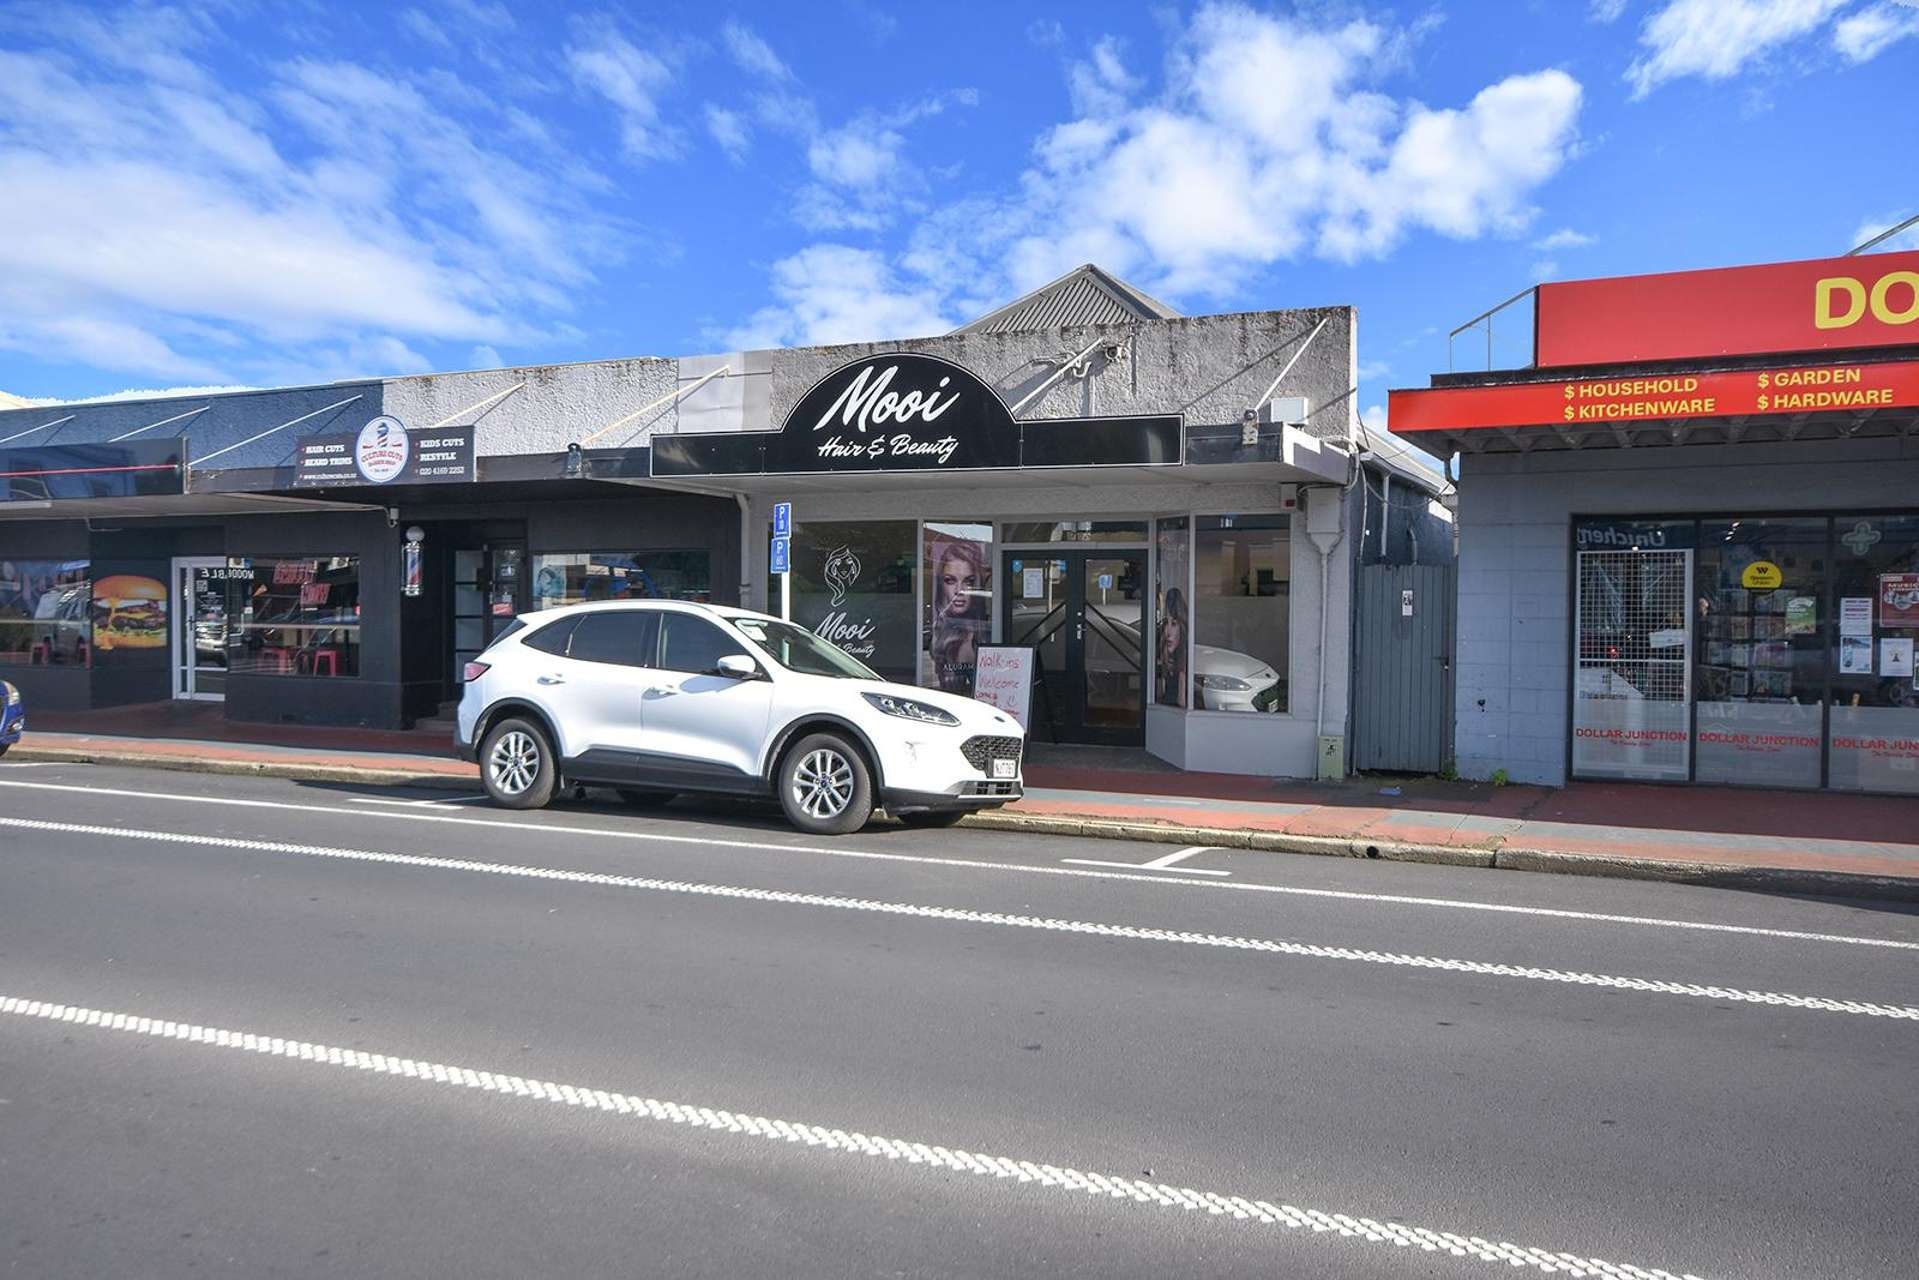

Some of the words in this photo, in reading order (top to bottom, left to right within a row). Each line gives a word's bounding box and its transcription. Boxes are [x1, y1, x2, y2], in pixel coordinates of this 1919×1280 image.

[1815, 271, 1919, 329] DO
[1774, 369, 1861, 386] GARDEN
[1579, 378, 1698, 398] HOUSEHOLD
[813, 366, 960, 432] Mooi
[1773, 389, 1893, 409] HARDWARE
[1579, 398, 1715, 419] KITCHENWARE
[306, 446, 324, 454] HAIR
[325, 444, 345, 453] CUTS
[420, 440, 440, 448] KIDS
[442, 438, 464, 447] CUTS
[818, 436, 866, 457] Hair
[867, 434, 885, 459] &
[890, 433, 959, 464] Beauty
[304, 458, 329, 467] BEARD
[330, 456, 353, 465] TRIMS
[420, 452, 457, 461] RESTYLE
[814, 611, 876, 642] Mooi
[1576, 728, 1623, 738] DOLLAR
[1624, 730, 1687, 741] JUNCTION
[1699, 732, 1749, 744] DOLLAR
[1753, 735, 1819, 747] JUNCTION
[1833, 737, 1888, 749] DOLLAR
